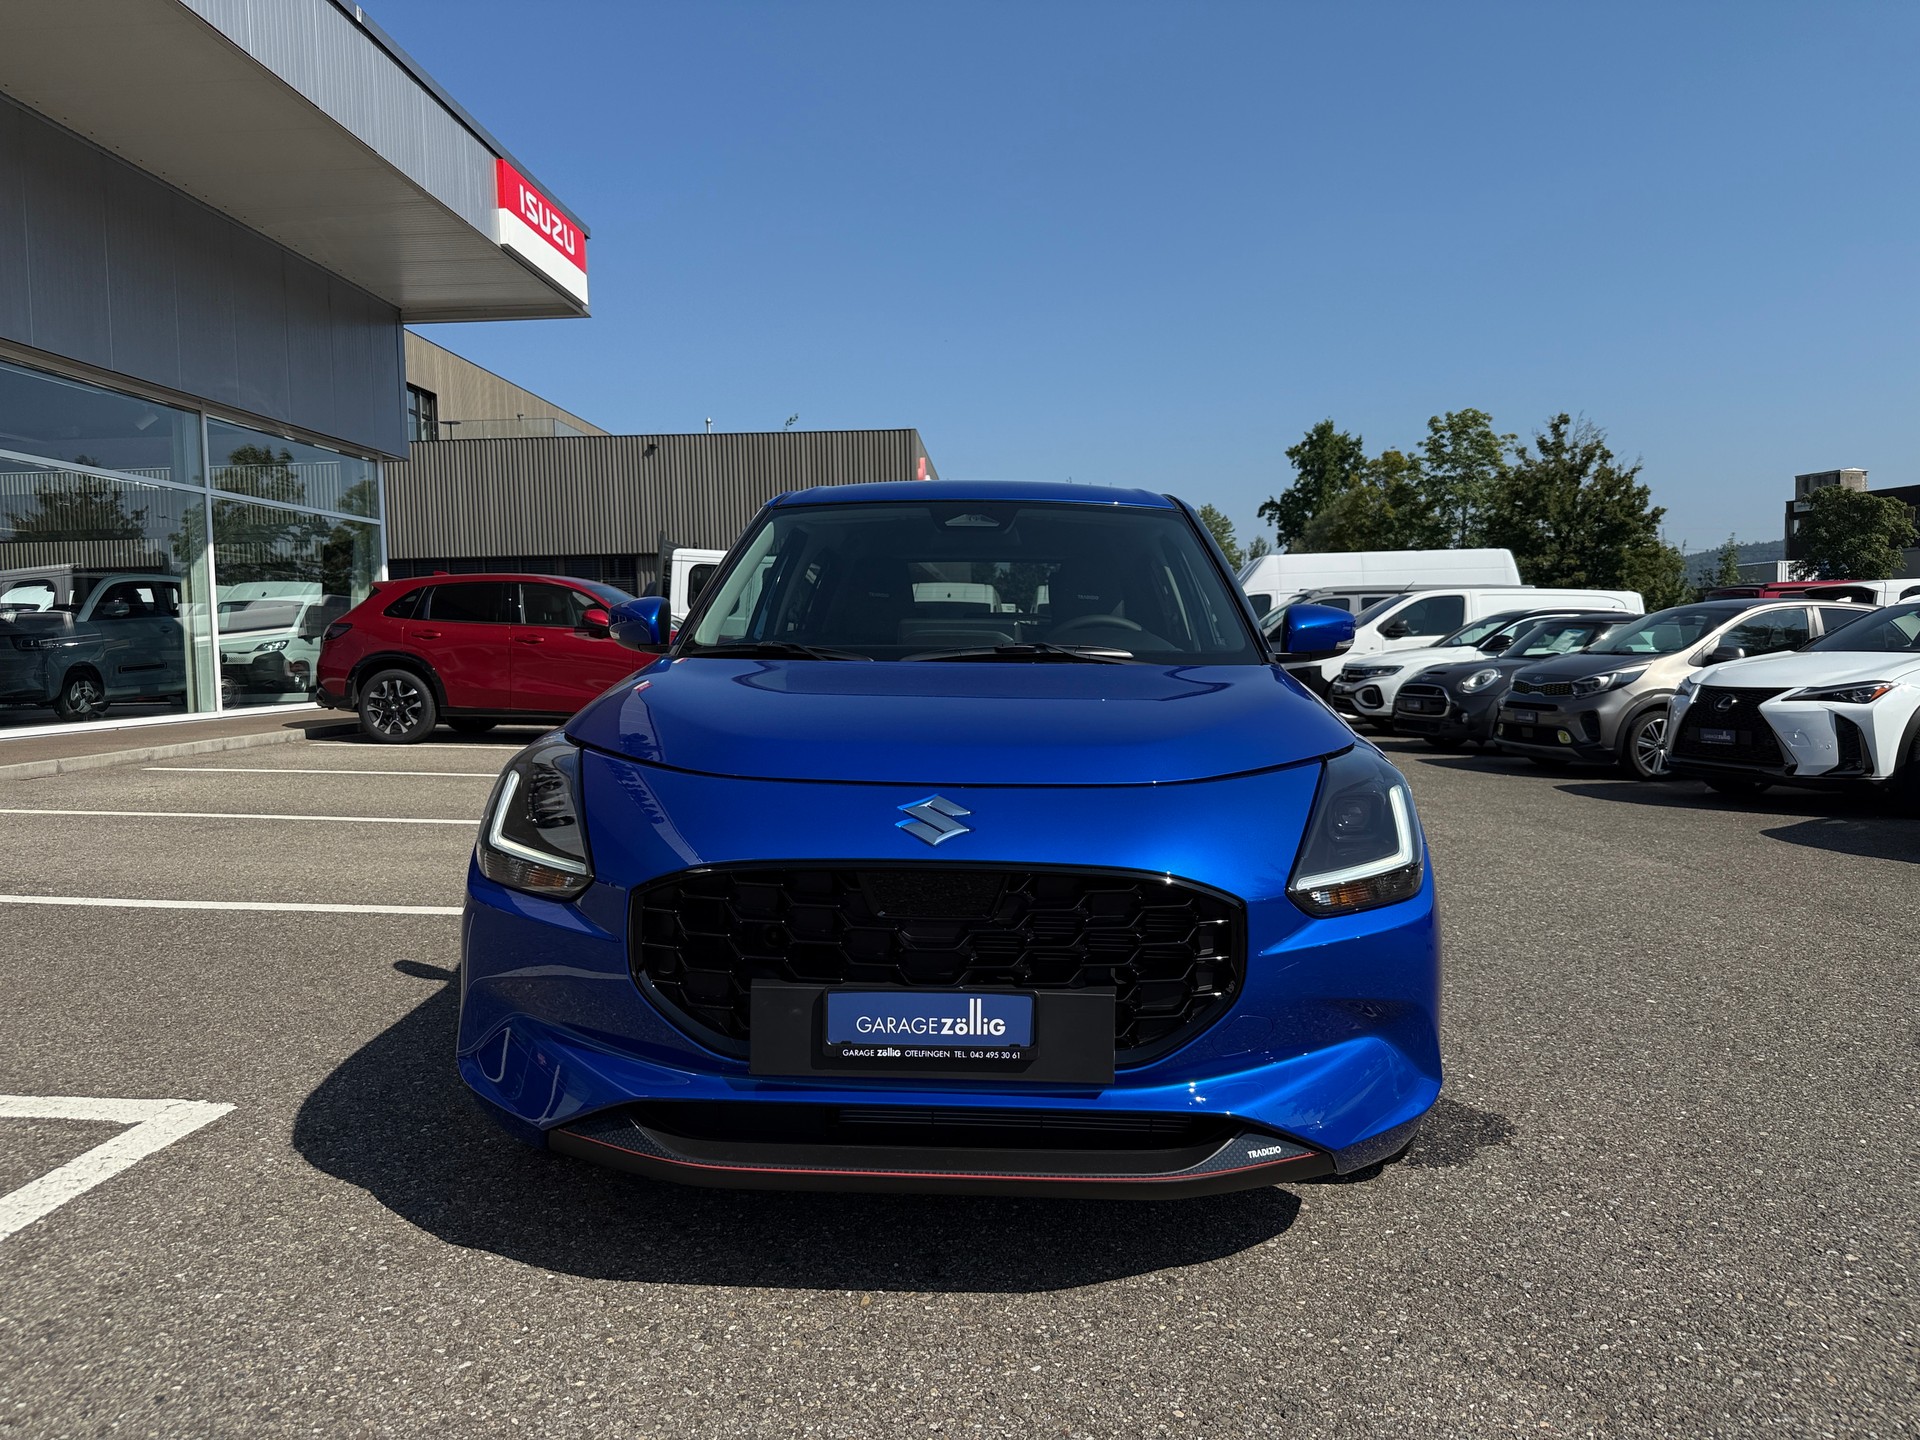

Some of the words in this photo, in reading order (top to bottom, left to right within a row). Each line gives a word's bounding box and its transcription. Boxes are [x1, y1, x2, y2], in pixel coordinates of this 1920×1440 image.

[519, 184, 575, 256] ISUZU
[856, 1016, 938, 1034] GARAGE
[842, 1049, 875, 1057] GARAGE
[904, 1050, 950, 1058] OTELFINGEN
[969, 1051, 984, 1059] 043
[985, 1051, 999, 1059] 495
[1000, 1051, 1011, 1059] 30
[1011, 1052, 1021, 1060] 61
[1247, 1145, 1282, 1159] TRADIZIO
